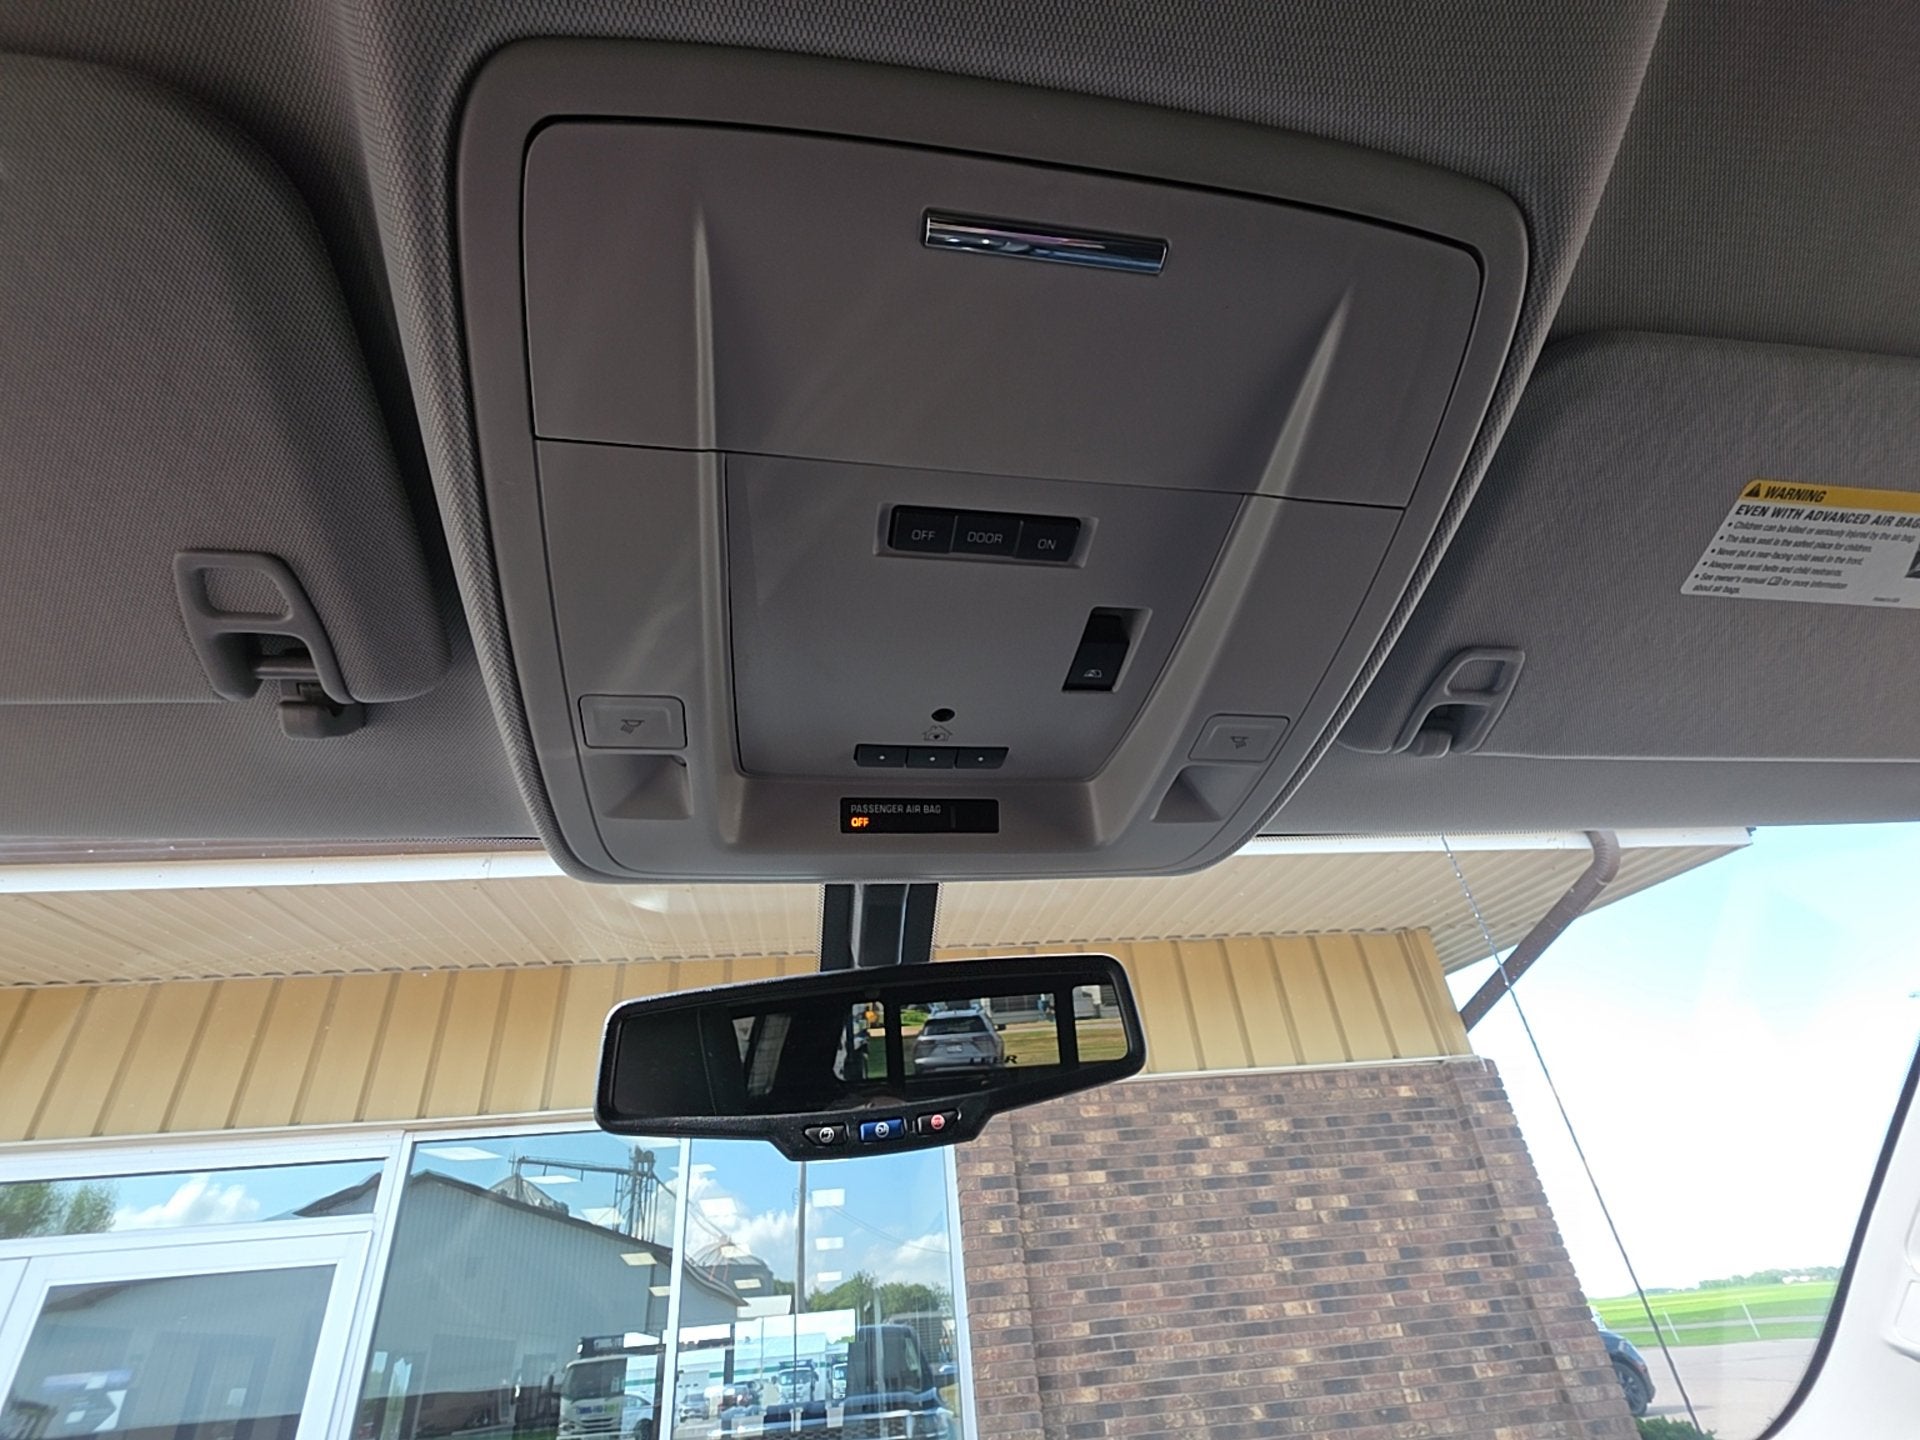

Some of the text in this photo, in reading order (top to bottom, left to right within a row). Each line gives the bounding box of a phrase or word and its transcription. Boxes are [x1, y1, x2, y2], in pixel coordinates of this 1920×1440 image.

[1764, 486, 1827, 503] WARNING
[1735, 504, 1920, 529] EVEN WITH ADVANCED AIR BAG
[911, 529, 936, 541] OFF
[966, 531, 1004, 544] DOOR
[1037, 538, 1056, 550] ON
[850, 804, 942, 814] PASSENGER AIR BAG
[850, 817, 869, 828] OFF
